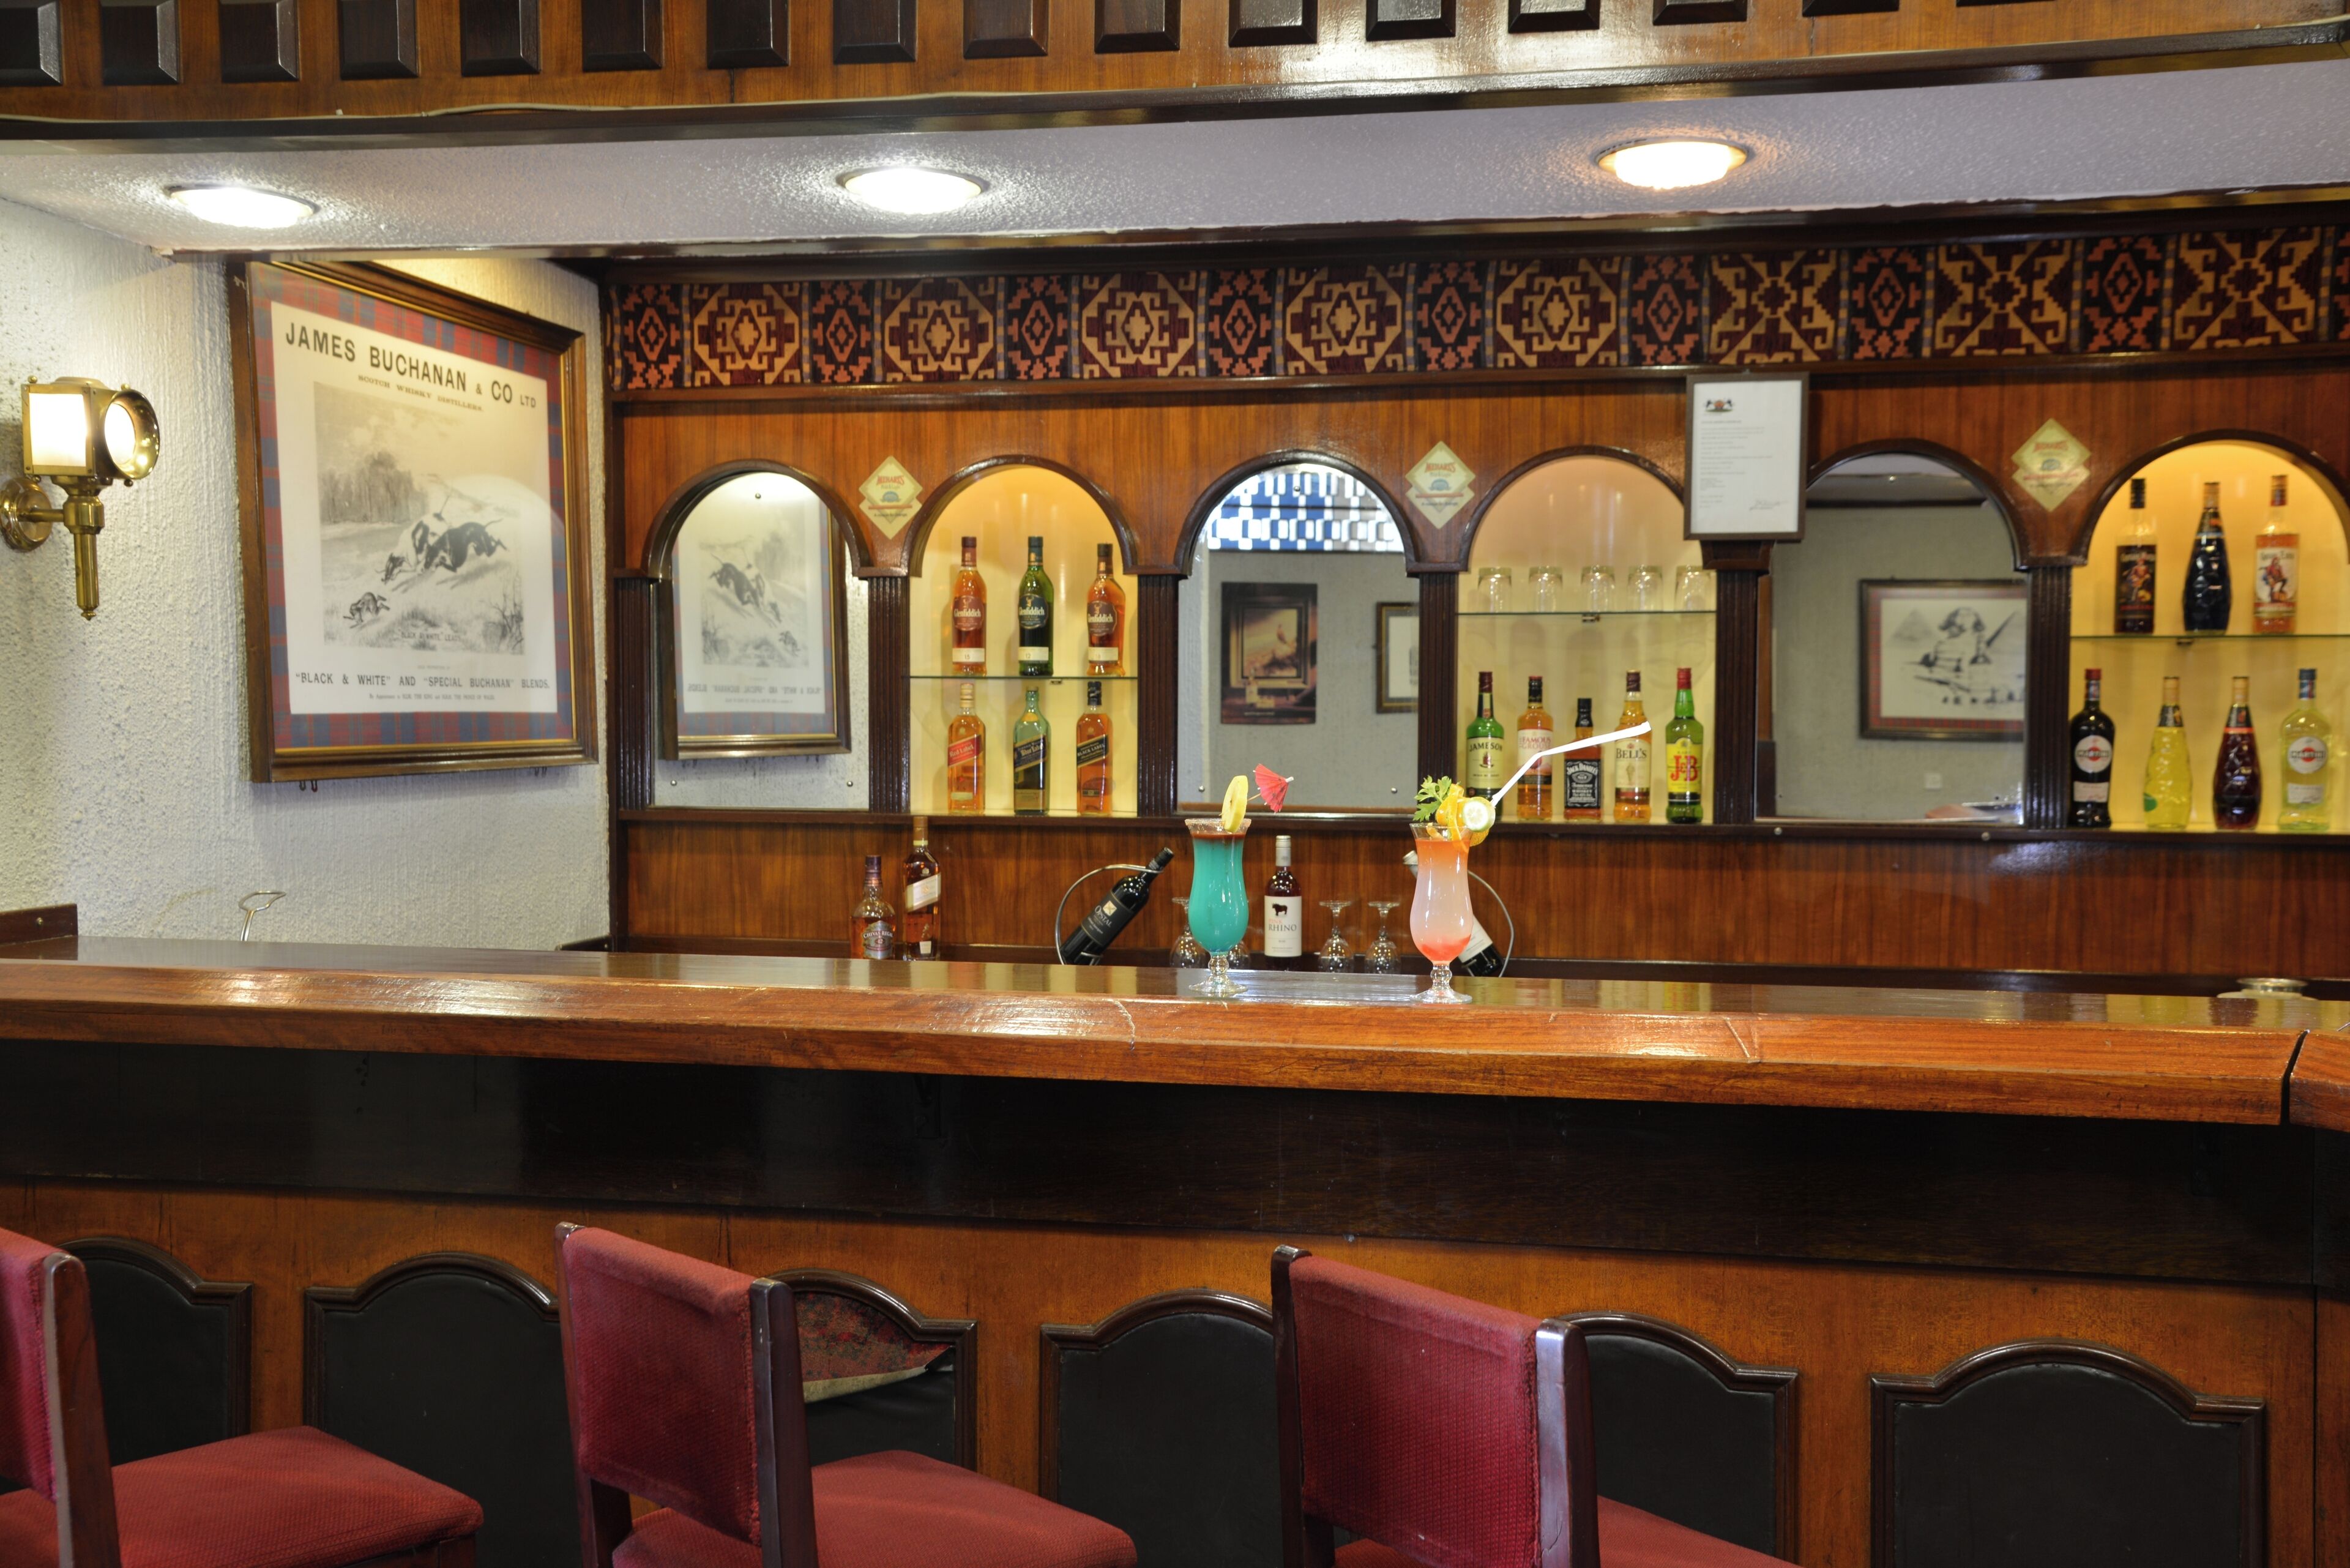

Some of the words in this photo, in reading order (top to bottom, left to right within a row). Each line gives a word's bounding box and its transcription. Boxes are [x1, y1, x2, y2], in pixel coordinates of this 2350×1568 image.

[286, 322, 356, 362] JAMES
[370, 345, 466, 392] BUCHANAN
[476, 383, 482, 395] &
[491, 380, 513, 404] CO
[520, 394, 537, 408] LTD
[358, 375, 390, 389] SCOTCH
[397, 384, 431, 399] WHISKY
[954, 608, 982, 618] Glenfiddich
[296, 672, 333, 684] "BLACK
[342, 674, 349, 685] &
[357, 674, 390, 686] WHITE"
[400, 676, 416, 686] AND
[423, 676, 463, 687] "SPECIAL
[470, 678, 514, 689] BUCHANAN"
